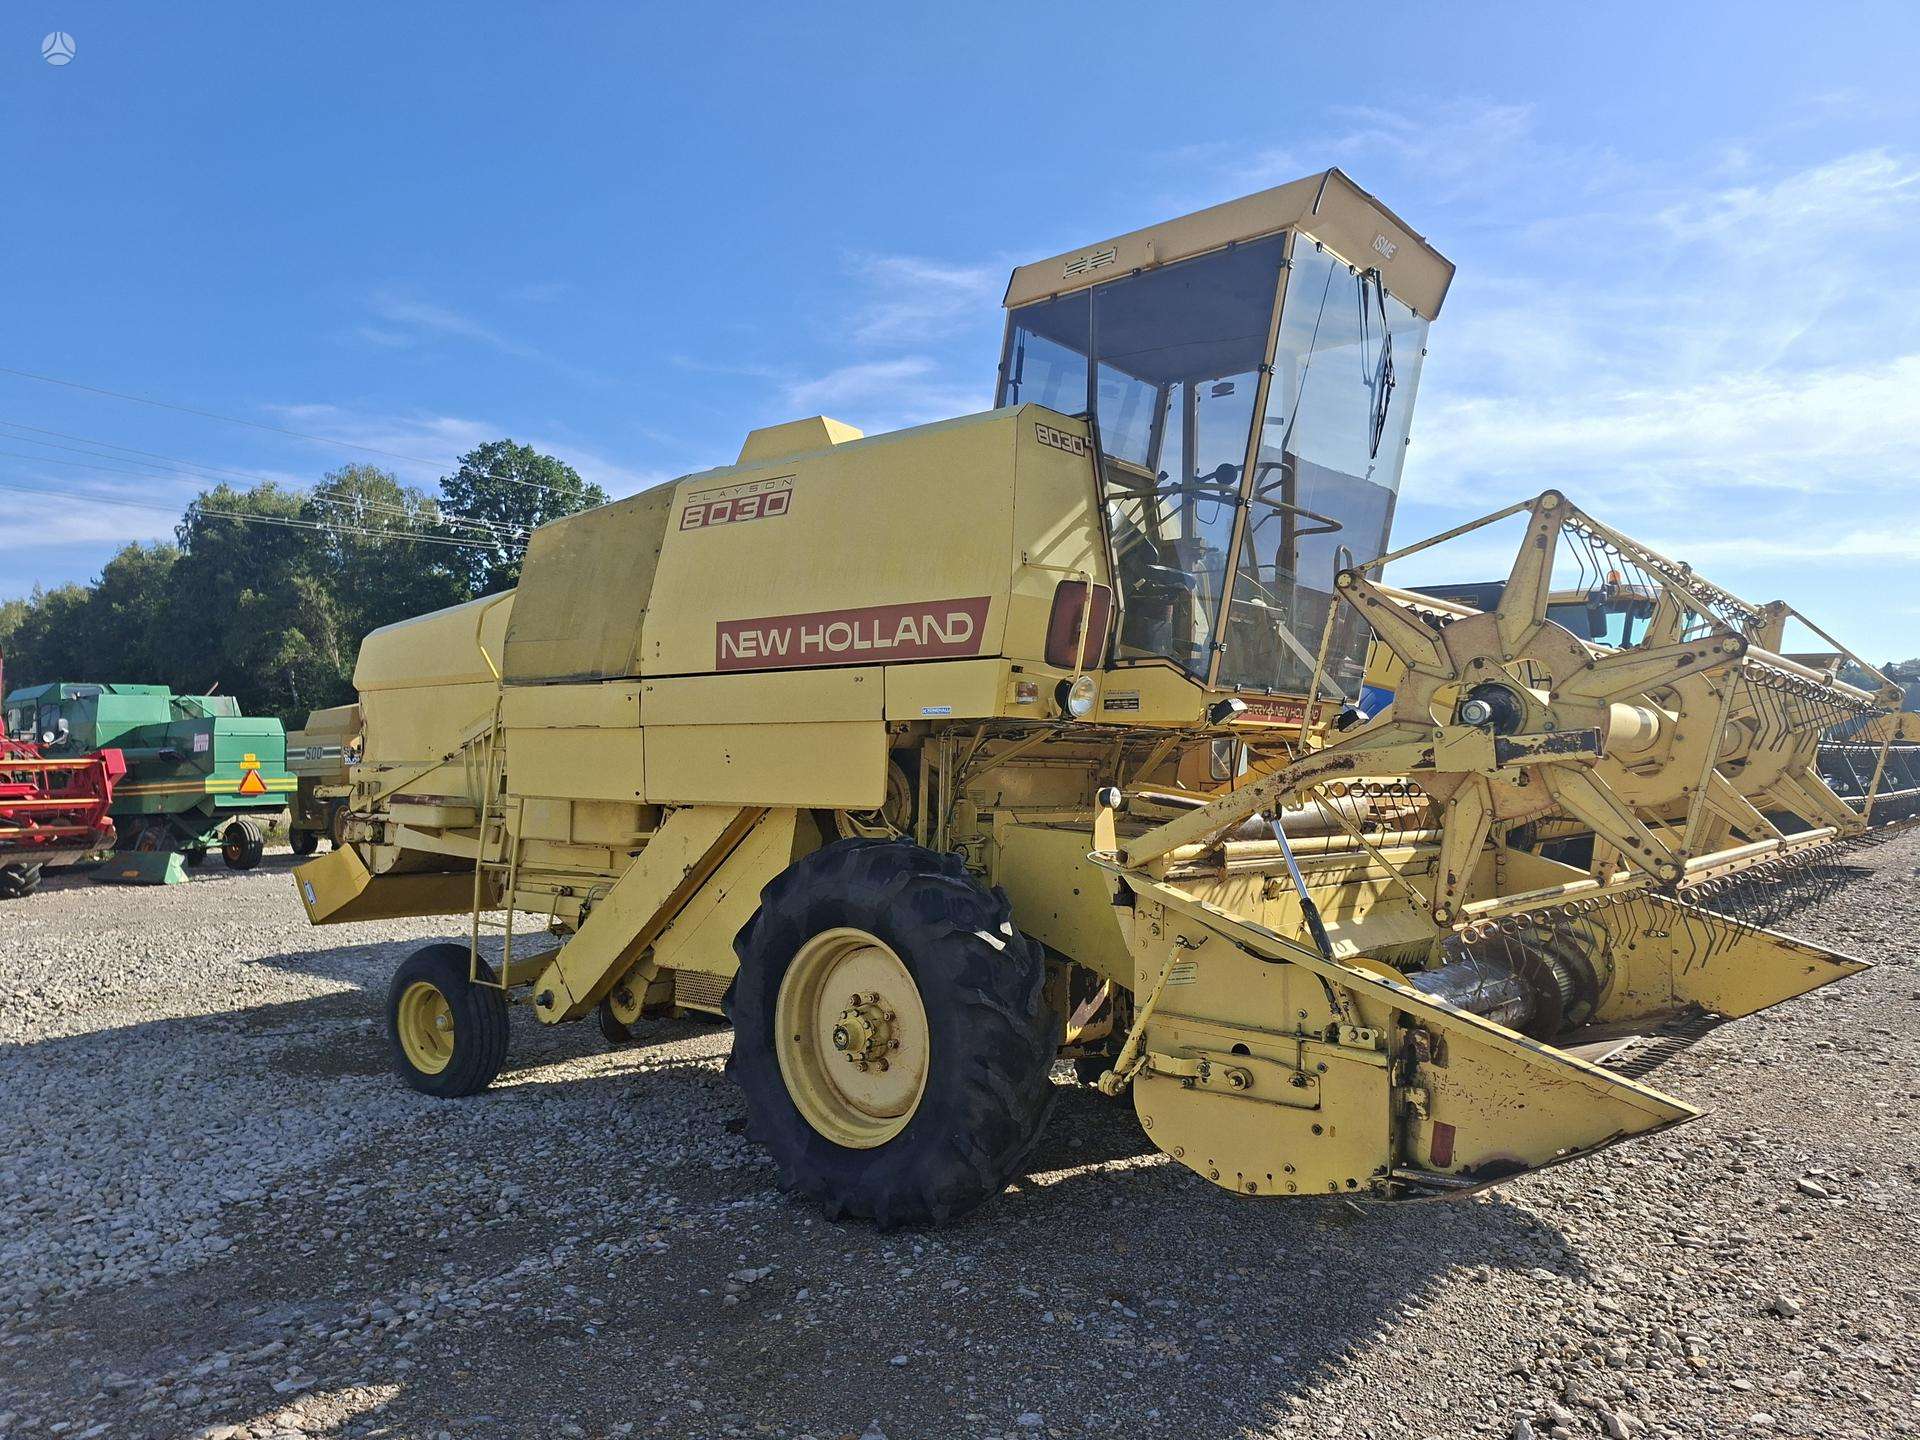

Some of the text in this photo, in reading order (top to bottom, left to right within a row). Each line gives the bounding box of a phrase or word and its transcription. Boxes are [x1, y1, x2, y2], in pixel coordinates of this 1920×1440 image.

[1372, 234, 1396, 259] ISME
[1036, 424, 1084, 456] 8030
[688, 479, 792, 504] CLAYSON
[682, 491, 790, 529] 8030
[721, 612, 974, 659] NEW HOLLAND
